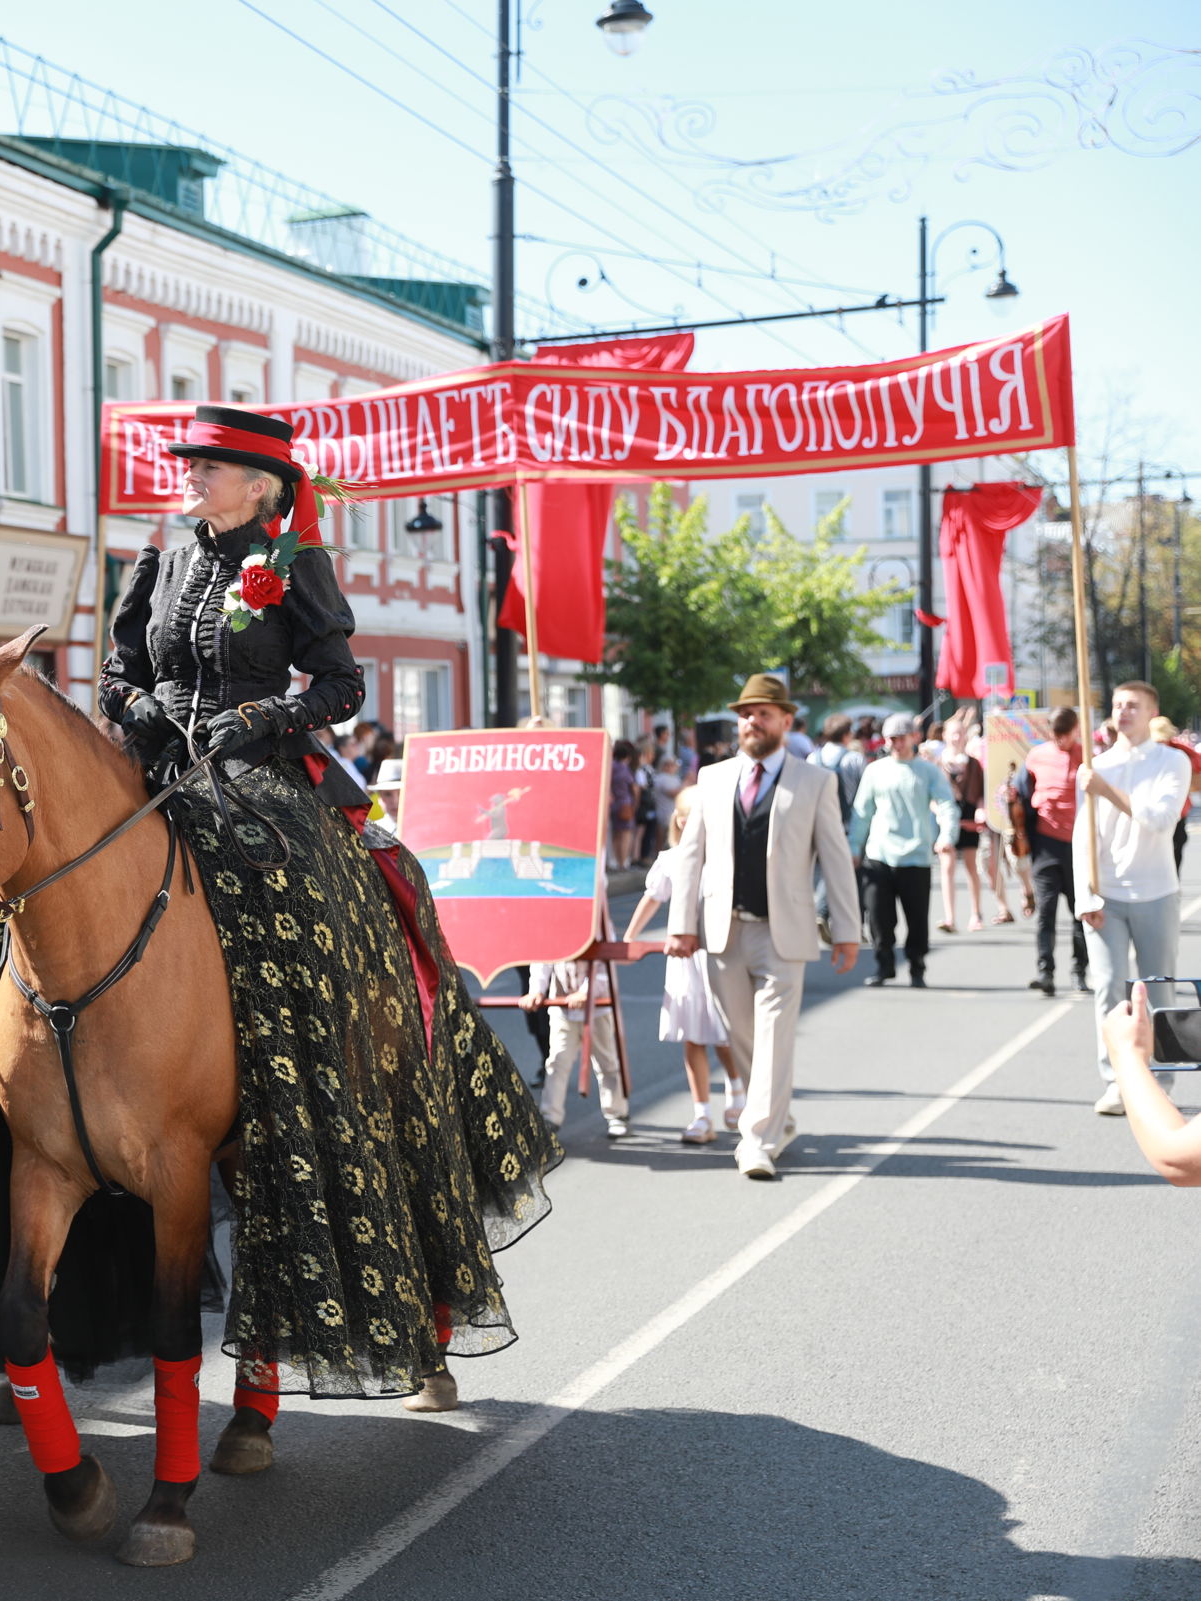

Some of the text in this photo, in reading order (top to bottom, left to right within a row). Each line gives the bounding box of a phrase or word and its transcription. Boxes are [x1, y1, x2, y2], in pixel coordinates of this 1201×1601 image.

[269, 383, 517, 481] ЗВЫШАЕТЪ
[524, 383, 640, 463] СИЛУ
[426, 743, 586, 775] РЫБИНСКЪ
